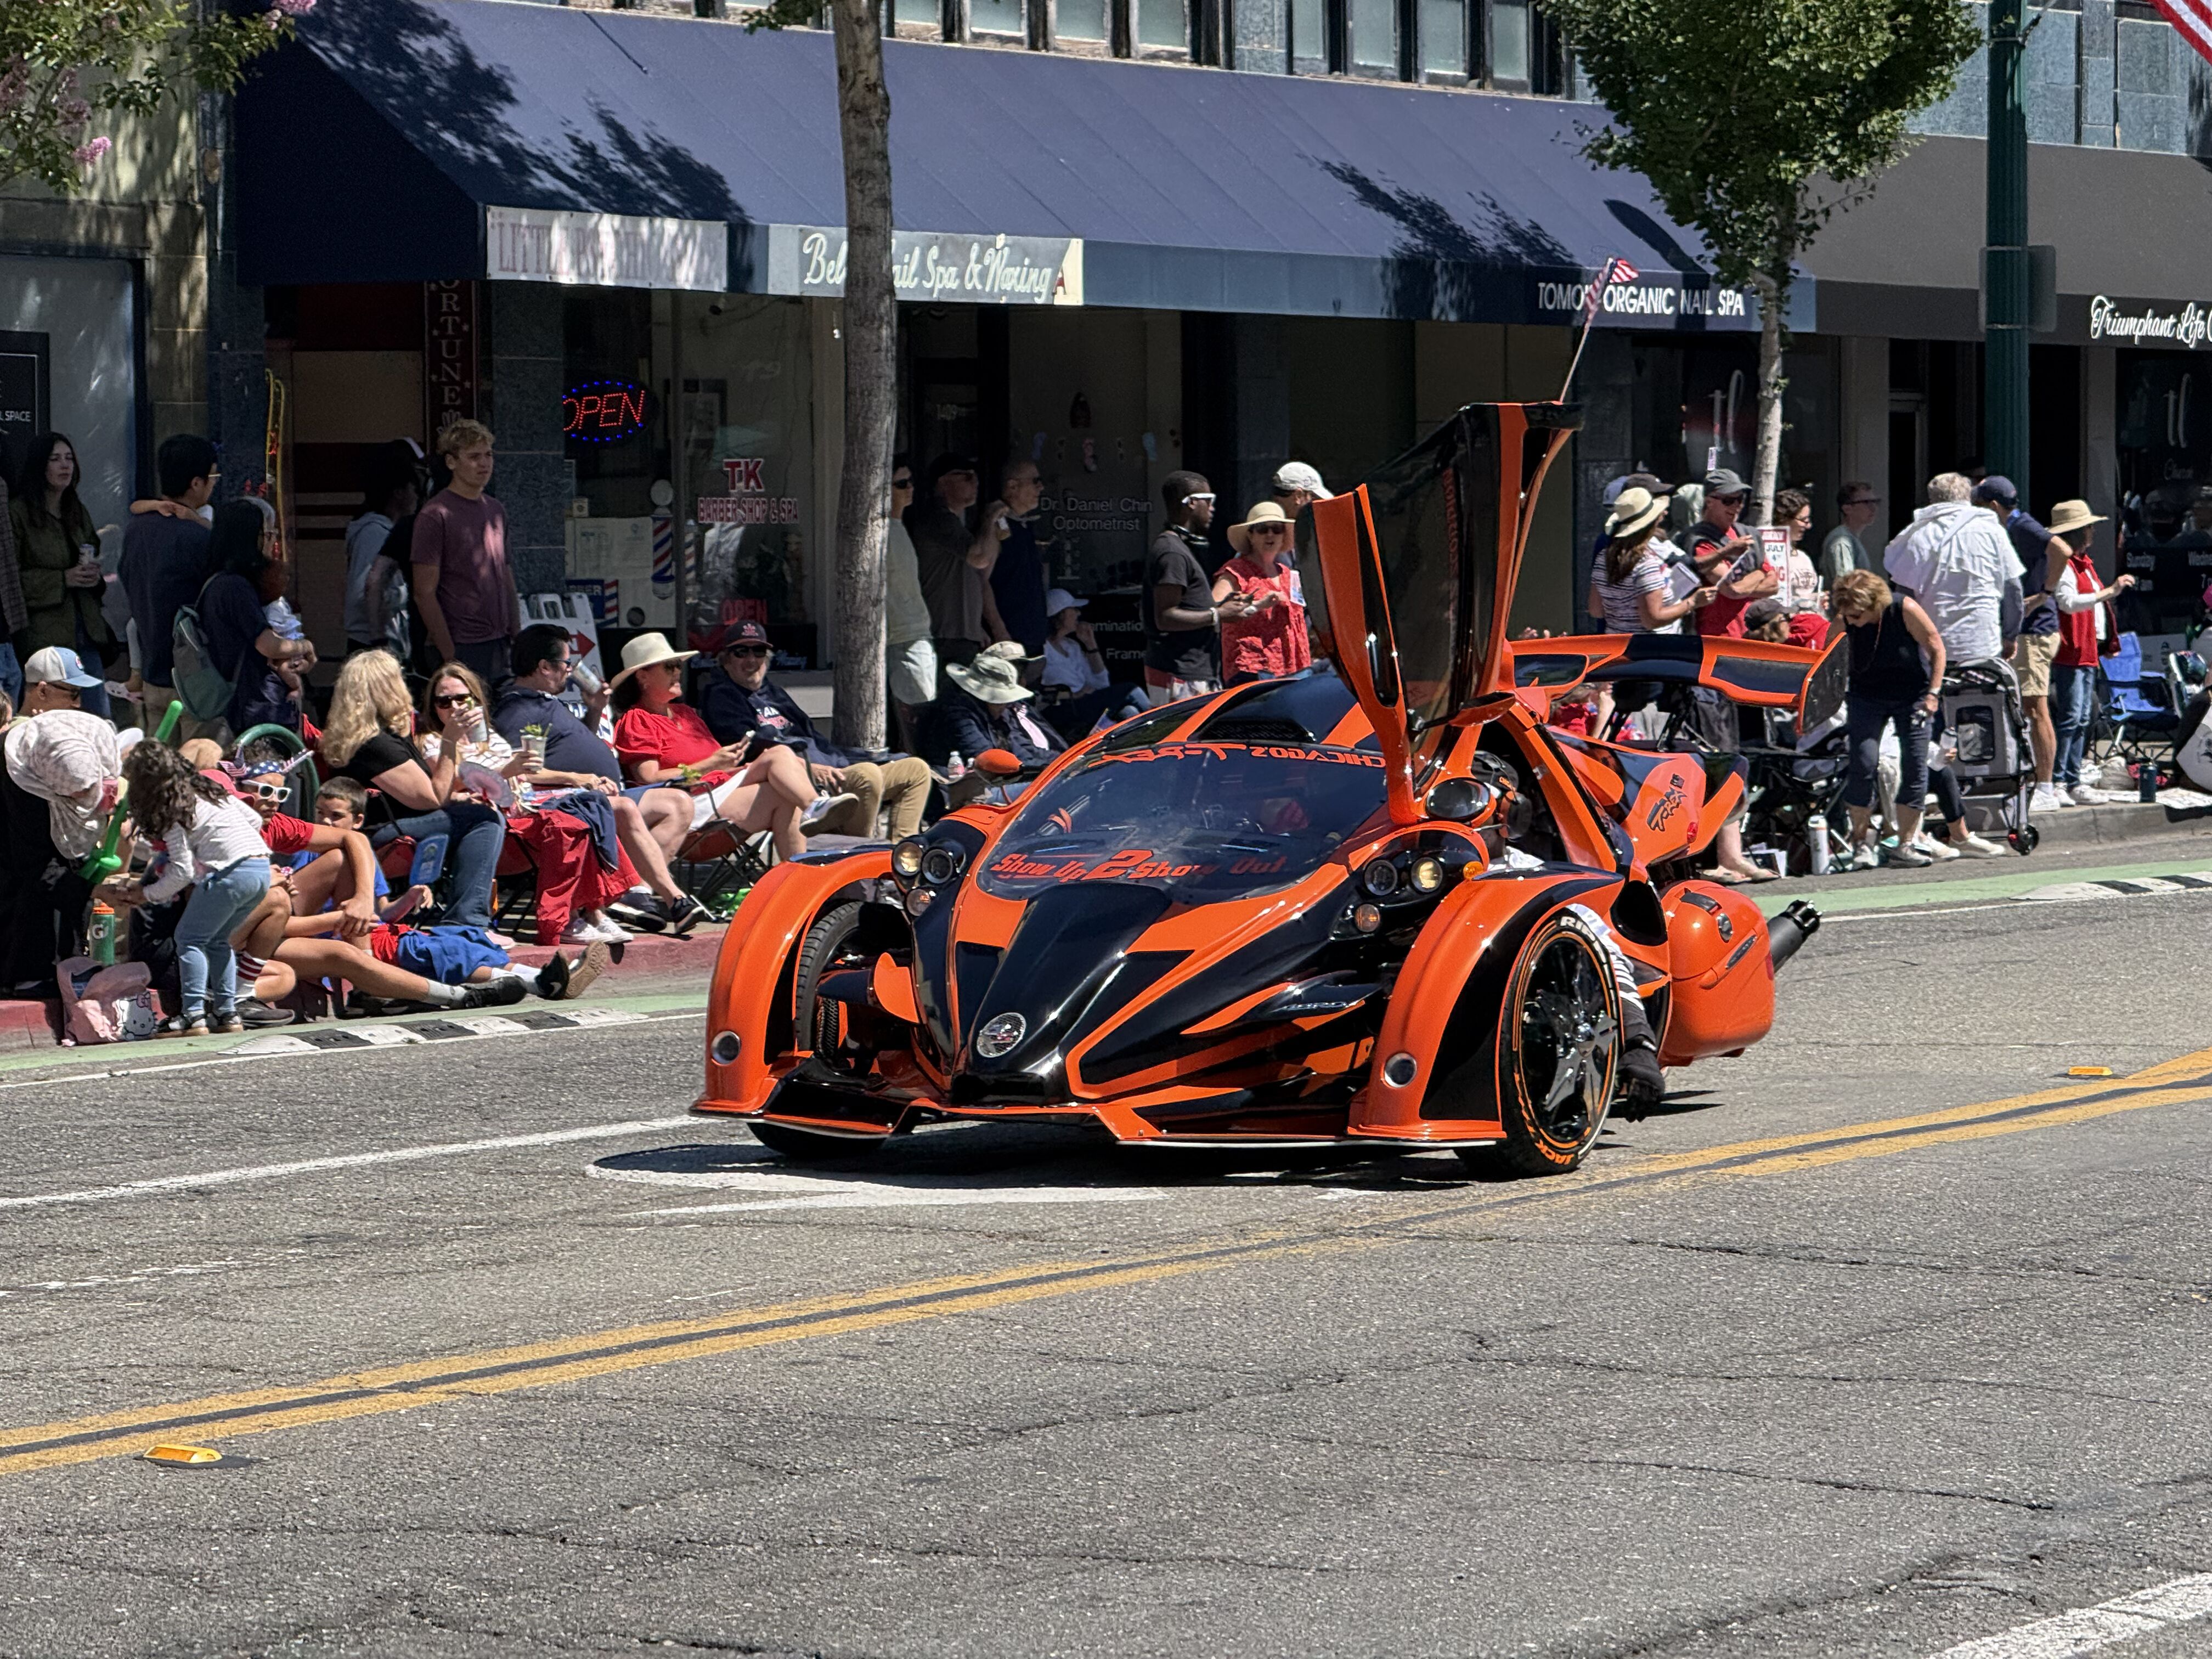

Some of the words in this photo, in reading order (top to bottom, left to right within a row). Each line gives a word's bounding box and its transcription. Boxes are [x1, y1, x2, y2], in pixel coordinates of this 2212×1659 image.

[923, 245, 960, 297] Spa
[964, 242, 982, 291] &
[1538, 282, 1594, 311] TOMO
[1603, 285, 1675, 315] ORGANIC
[1680, 289, 1713, 315] NAIL
[1718, 289, 1746, 317] SPA
[2091, 295, 2177, 346] Triumphant
[2177, 301, 2206, 349] Life
[5, 410, 31, 422] SPACE
[563, 390, 645, 431] OPEN
[723, 458, 765, 492] TK
[698, 498, 737, 523] BARBER
[738, 498, 767, 523] SHOP
[780, 499, 799, 524] SPA
[1041, 497, 1060, 511] Dr.
[1067, 498, 1113, 511] Daniel
[1120, 498, 1153, 512] Chin
[1053, 516, 1140, 531] Optometrist
[2126, 552, 2155, 571] Sunday
[722, 599, 768, 624] OPEN
[991, 853, 1053, 873] Show
[1053, 861, 1087, 882] Up
[1084, 849, 1154, 881] 2
[1534, 1139, 1575, 1165] JACK
